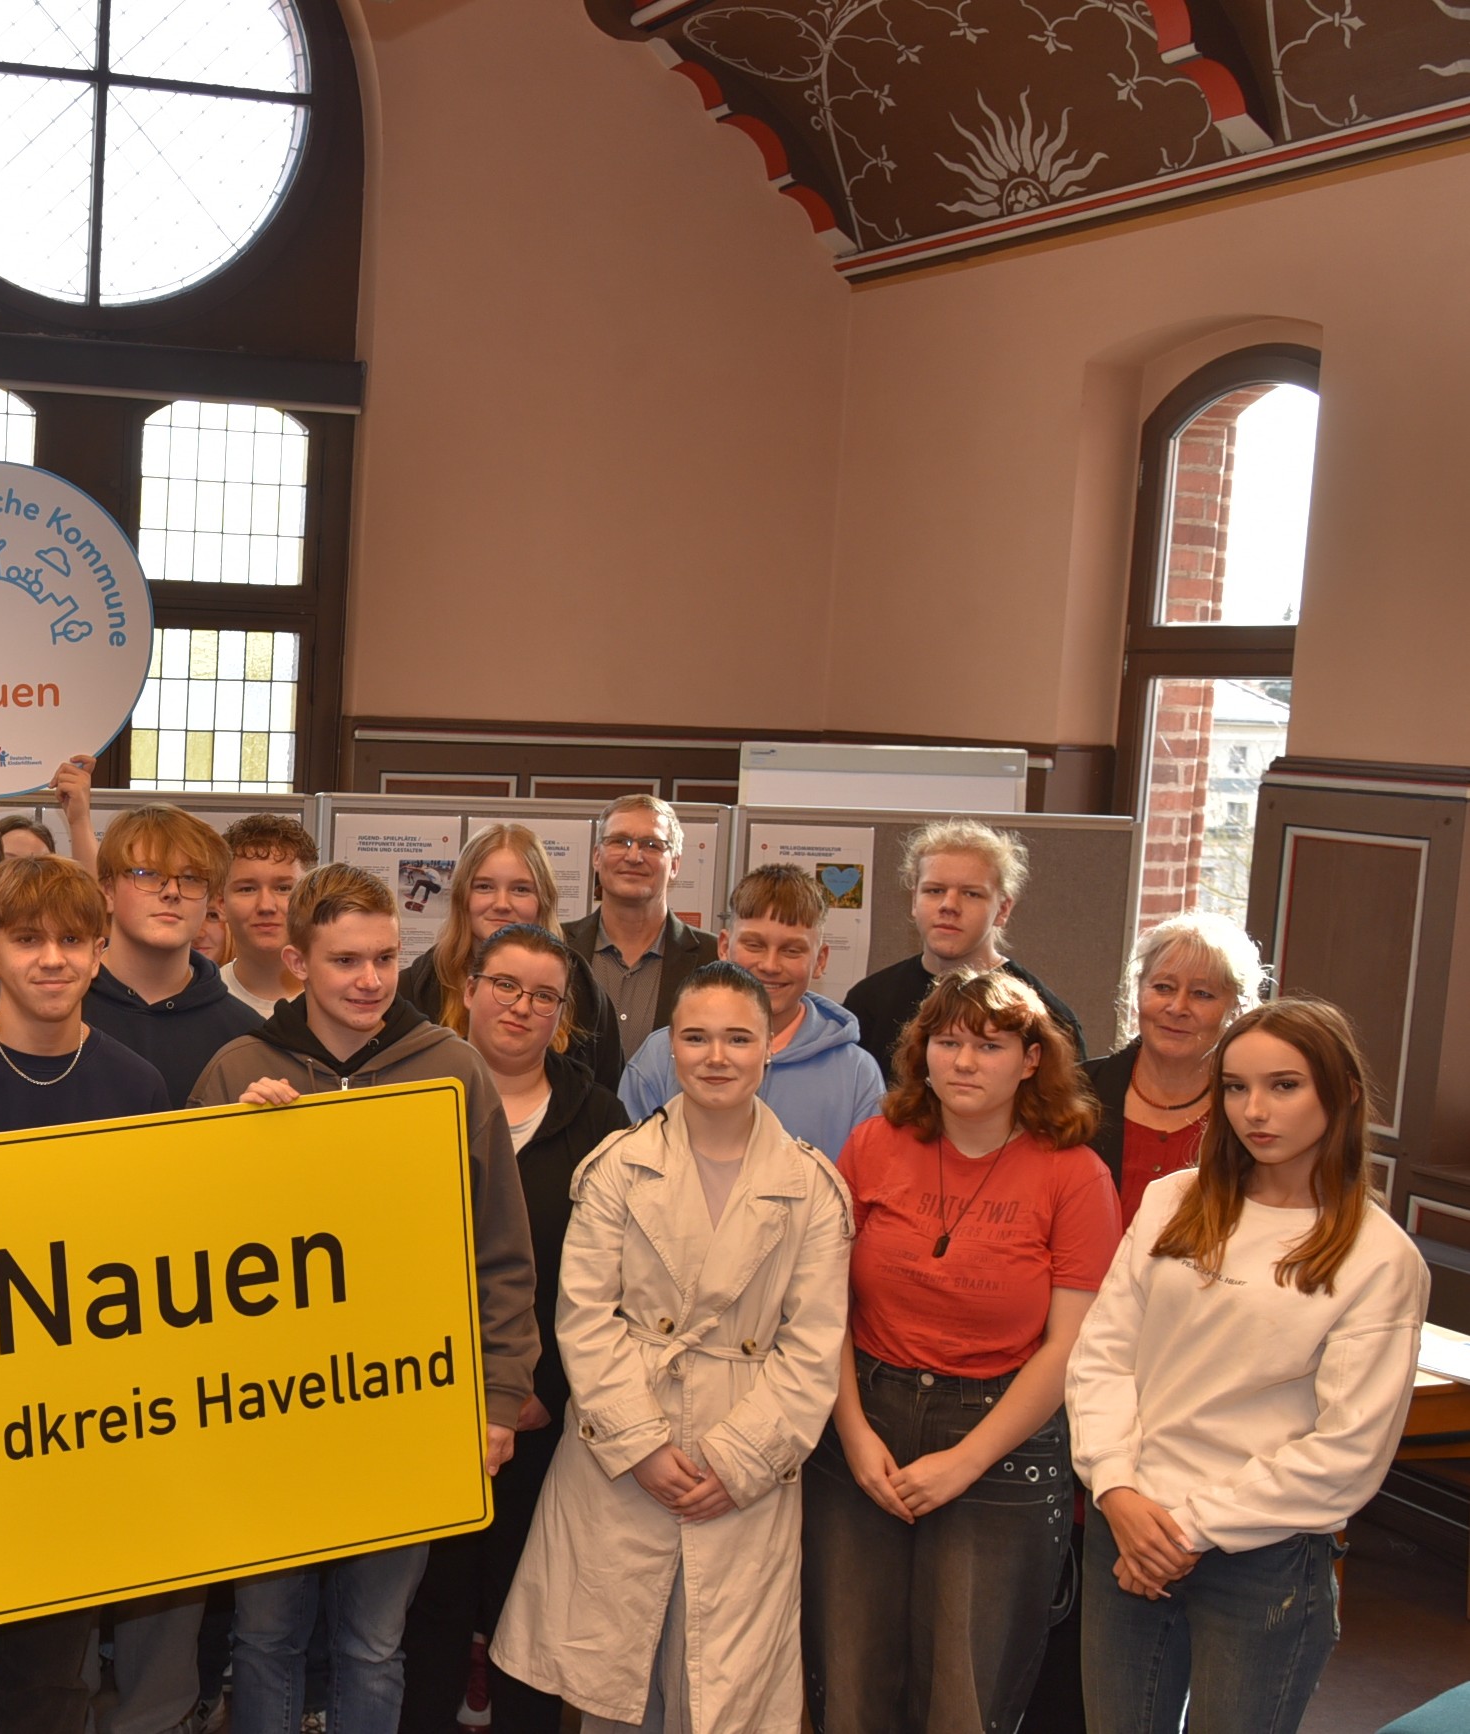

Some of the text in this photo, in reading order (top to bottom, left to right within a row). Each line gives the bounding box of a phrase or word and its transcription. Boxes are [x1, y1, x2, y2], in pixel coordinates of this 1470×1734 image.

[46, 506, 127, 648] Kommune
[916, 1192, 1021, 1225] SIXTY-TWO
[196, 1335, 456, 1428] Havelland
